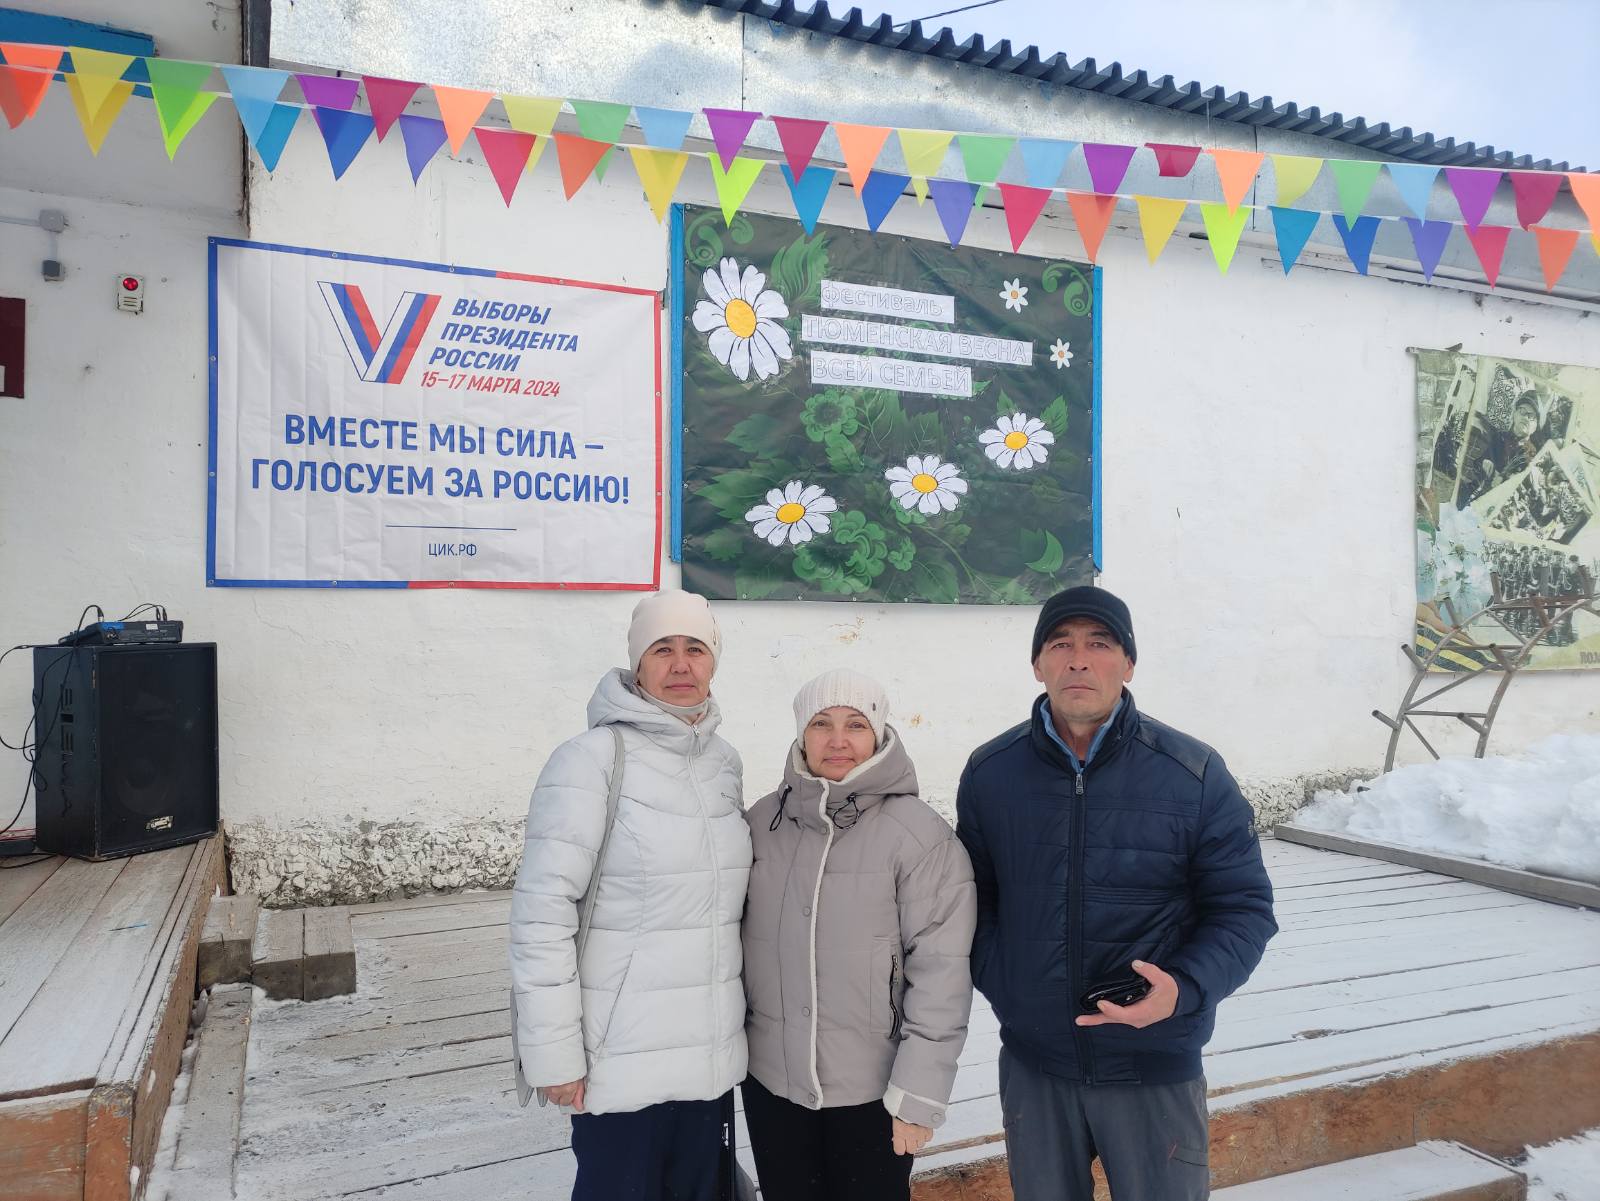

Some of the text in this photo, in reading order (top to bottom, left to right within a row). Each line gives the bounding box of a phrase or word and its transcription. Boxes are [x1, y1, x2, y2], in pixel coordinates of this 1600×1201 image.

[450, 297, 551, 326] ВЫБОРЫ
[440, 321, 579, 353] ПРЕЗИДЕНТА
[803, 316, 953, 354] ТЮМЕНСКАЯ
[428, 346, 521, 372] РОССИИ
[812, 356, 970, 392] ВСЕЙ СЕМЬЕЙ
[420, 371, 561, 398] 15–17 МАРТА 2024
[284, 413, 418, 452] ВМЕСТЕ
[428, 422, 486, 456] МЫ
[495, 427, 577, 460] СИЛА
[250, 457, 631, 506] ГОЛОСУЕМ ЗА РОССИЮ!
[427, 543, 478, 558] ЦИК.РФ
